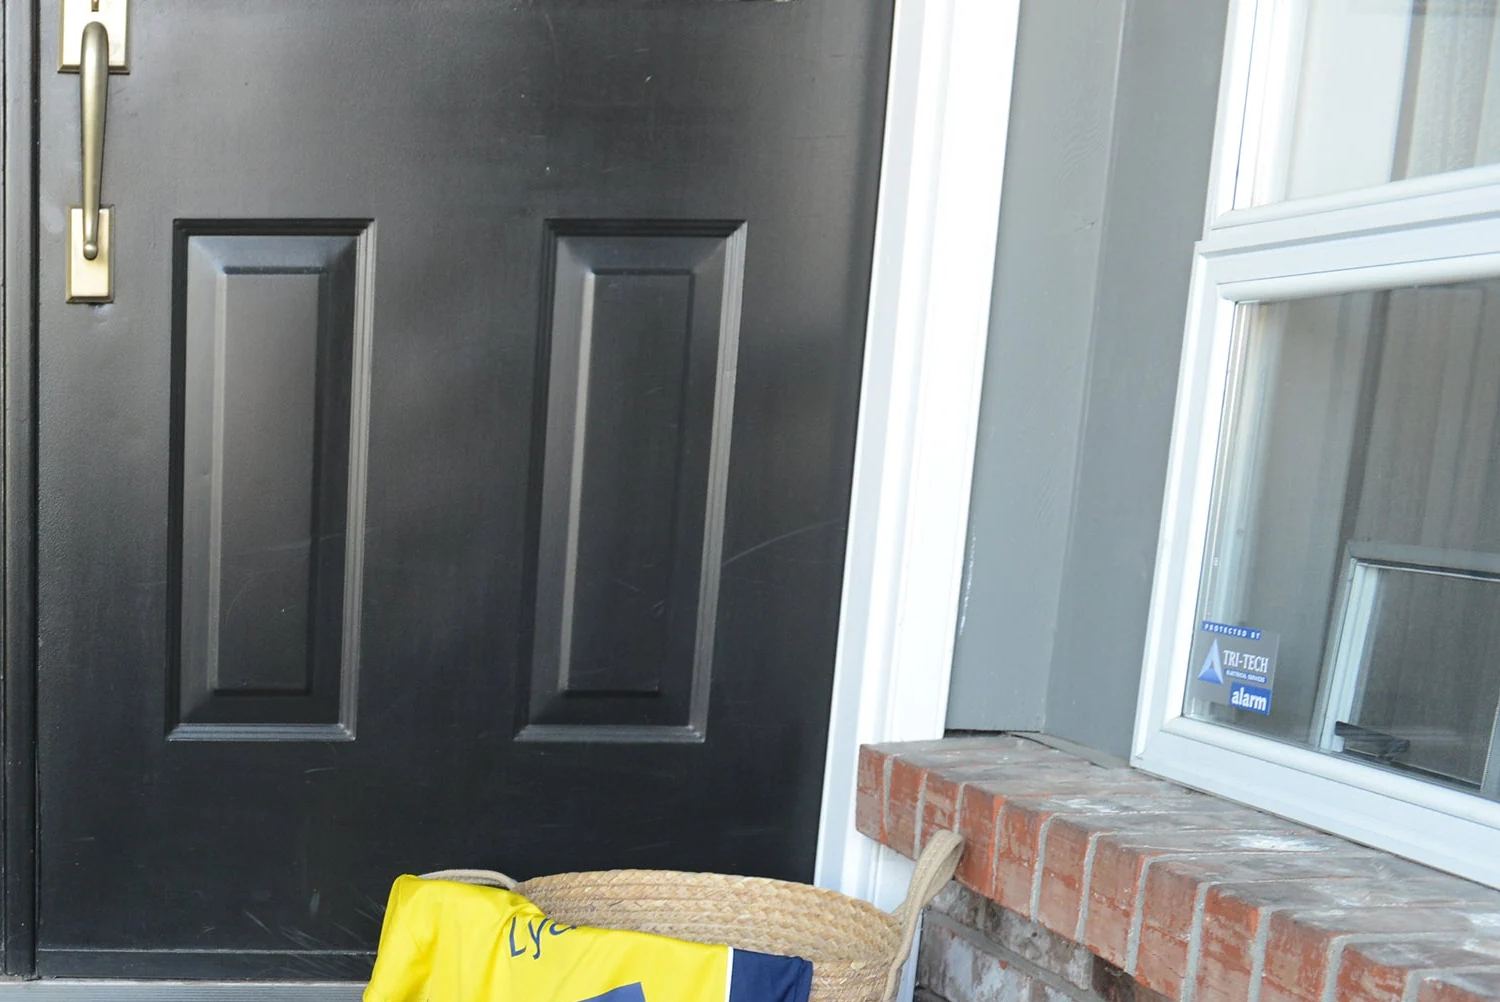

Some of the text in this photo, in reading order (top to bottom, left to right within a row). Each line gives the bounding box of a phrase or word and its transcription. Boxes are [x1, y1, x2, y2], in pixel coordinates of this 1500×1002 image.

[1204, 623, 1261, 640] PROTECTED BY
[1223, 649, 1269, 673] TRI-TECH
[1231, 686, 1268, 711] alarm
